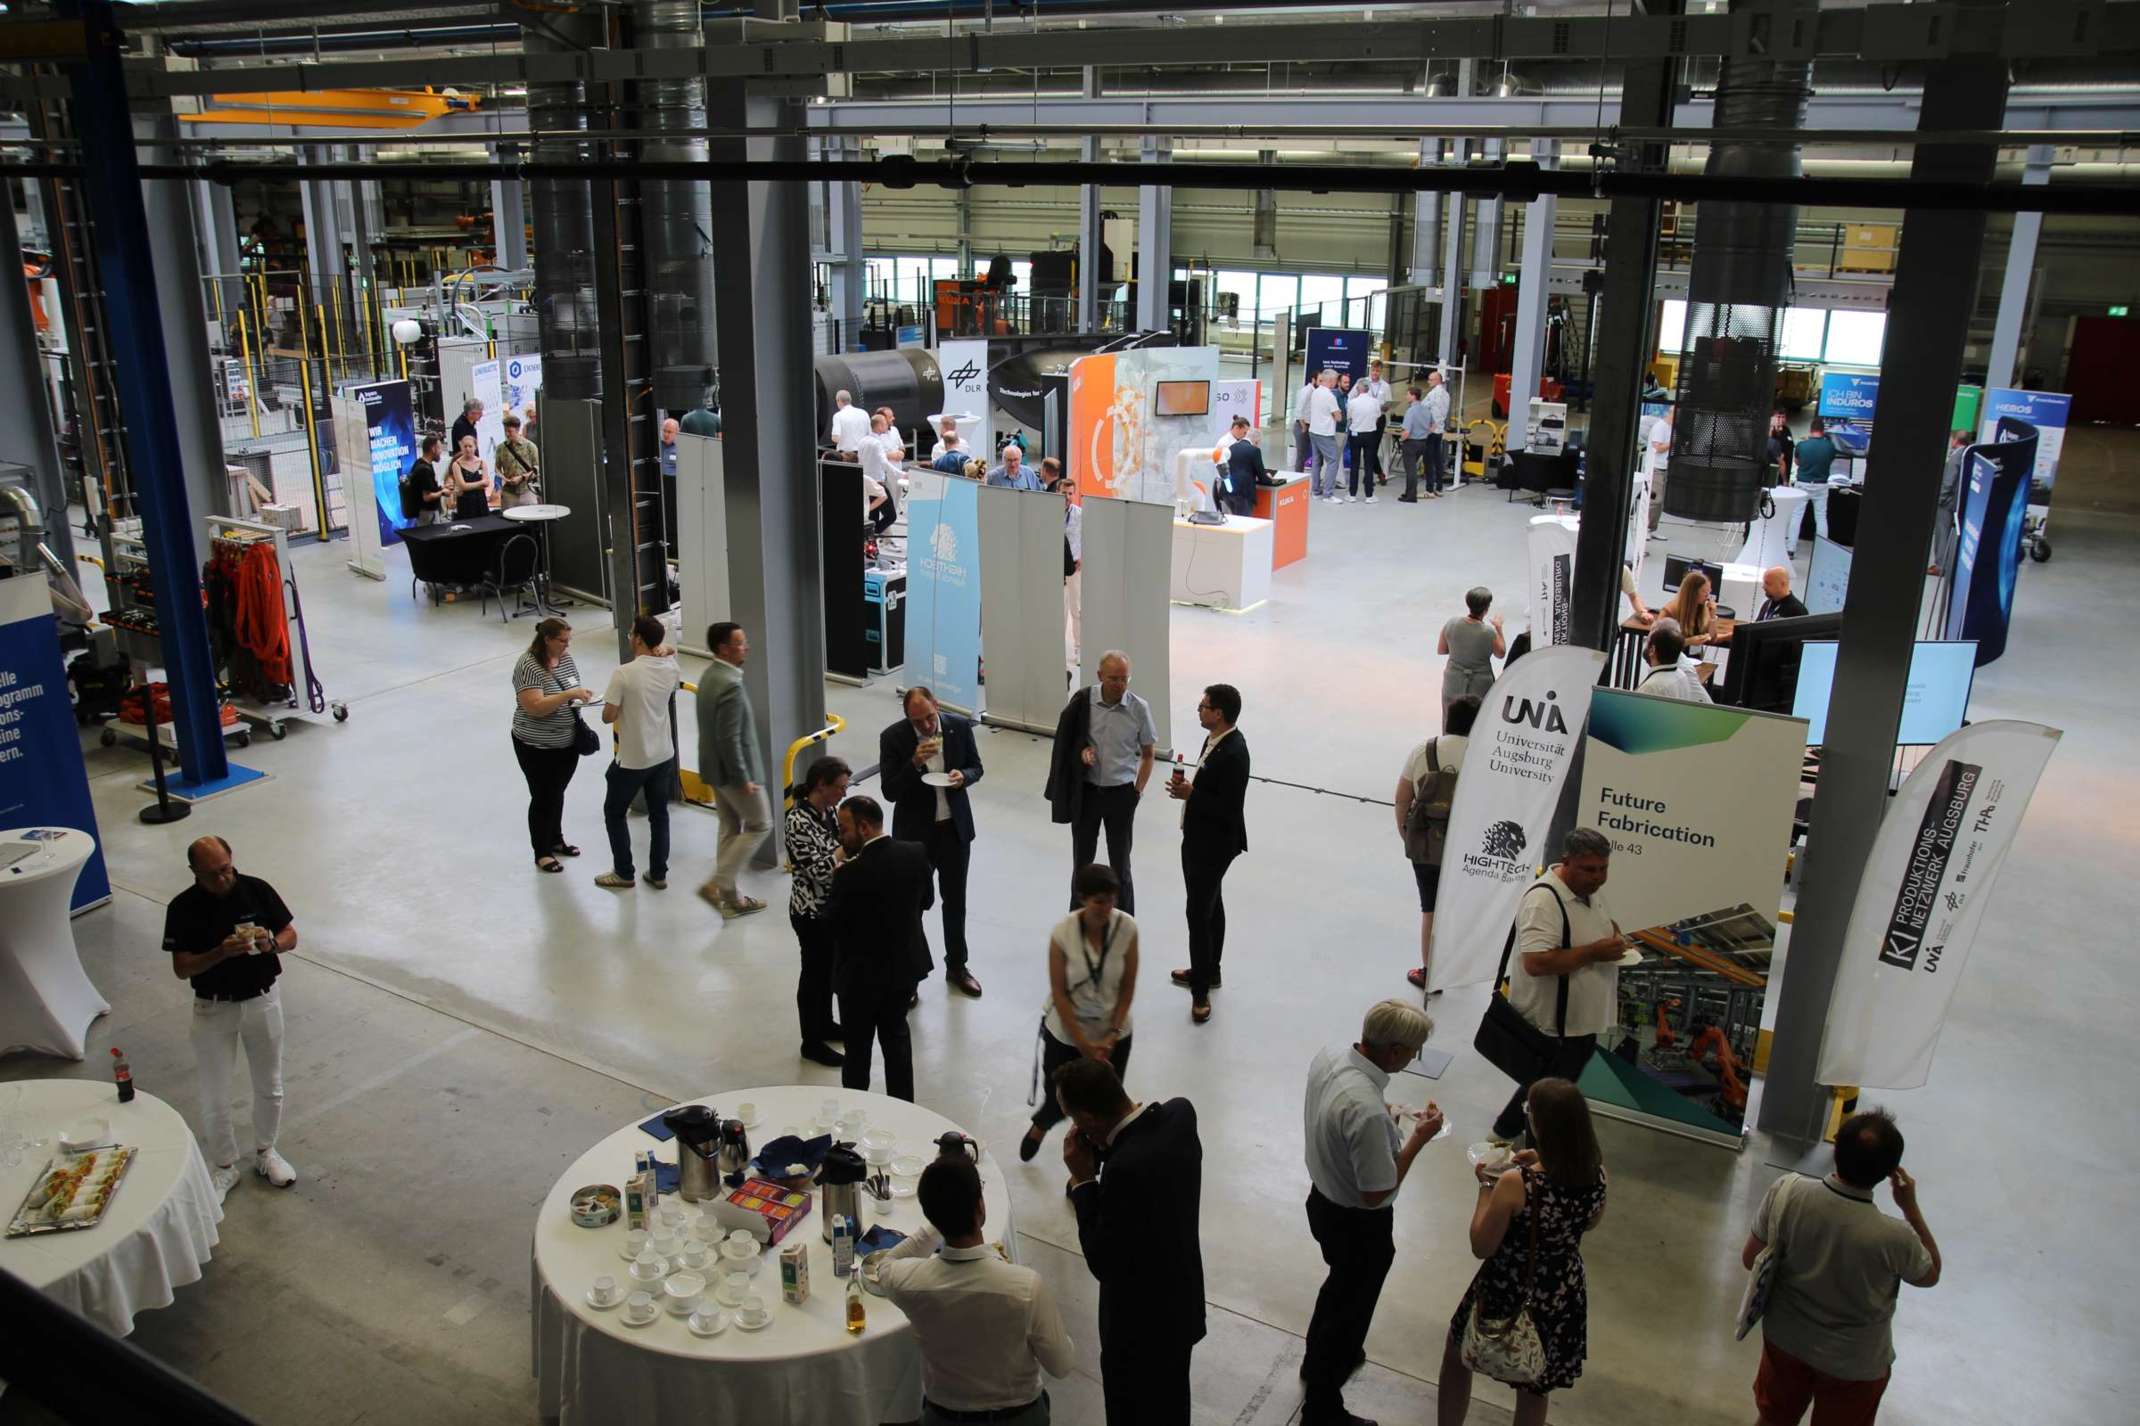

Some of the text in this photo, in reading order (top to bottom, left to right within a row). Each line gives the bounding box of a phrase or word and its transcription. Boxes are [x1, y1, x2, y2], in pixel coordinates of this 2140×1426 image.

[965, 384, 982, 392] DLR
[0, 728, 21, 744] ine
[1496, 730, 1565, 757] Universität
[1492, 745, 1553, 770] Augsburg
[1489, 759, 1554, 784] University
[1600, 787, 1666, 814] Future
[1598, 810, 1715, 848] Fabrication
[1626, 843, 1642, 856] 43
[1910, 854, 1945, 929] NETZWERK
[1937, 771, 1976, 850] AUGSBURG
[1463, 864, 1499, 880] Agenda
[1886, 930, 1919, 963] KI
